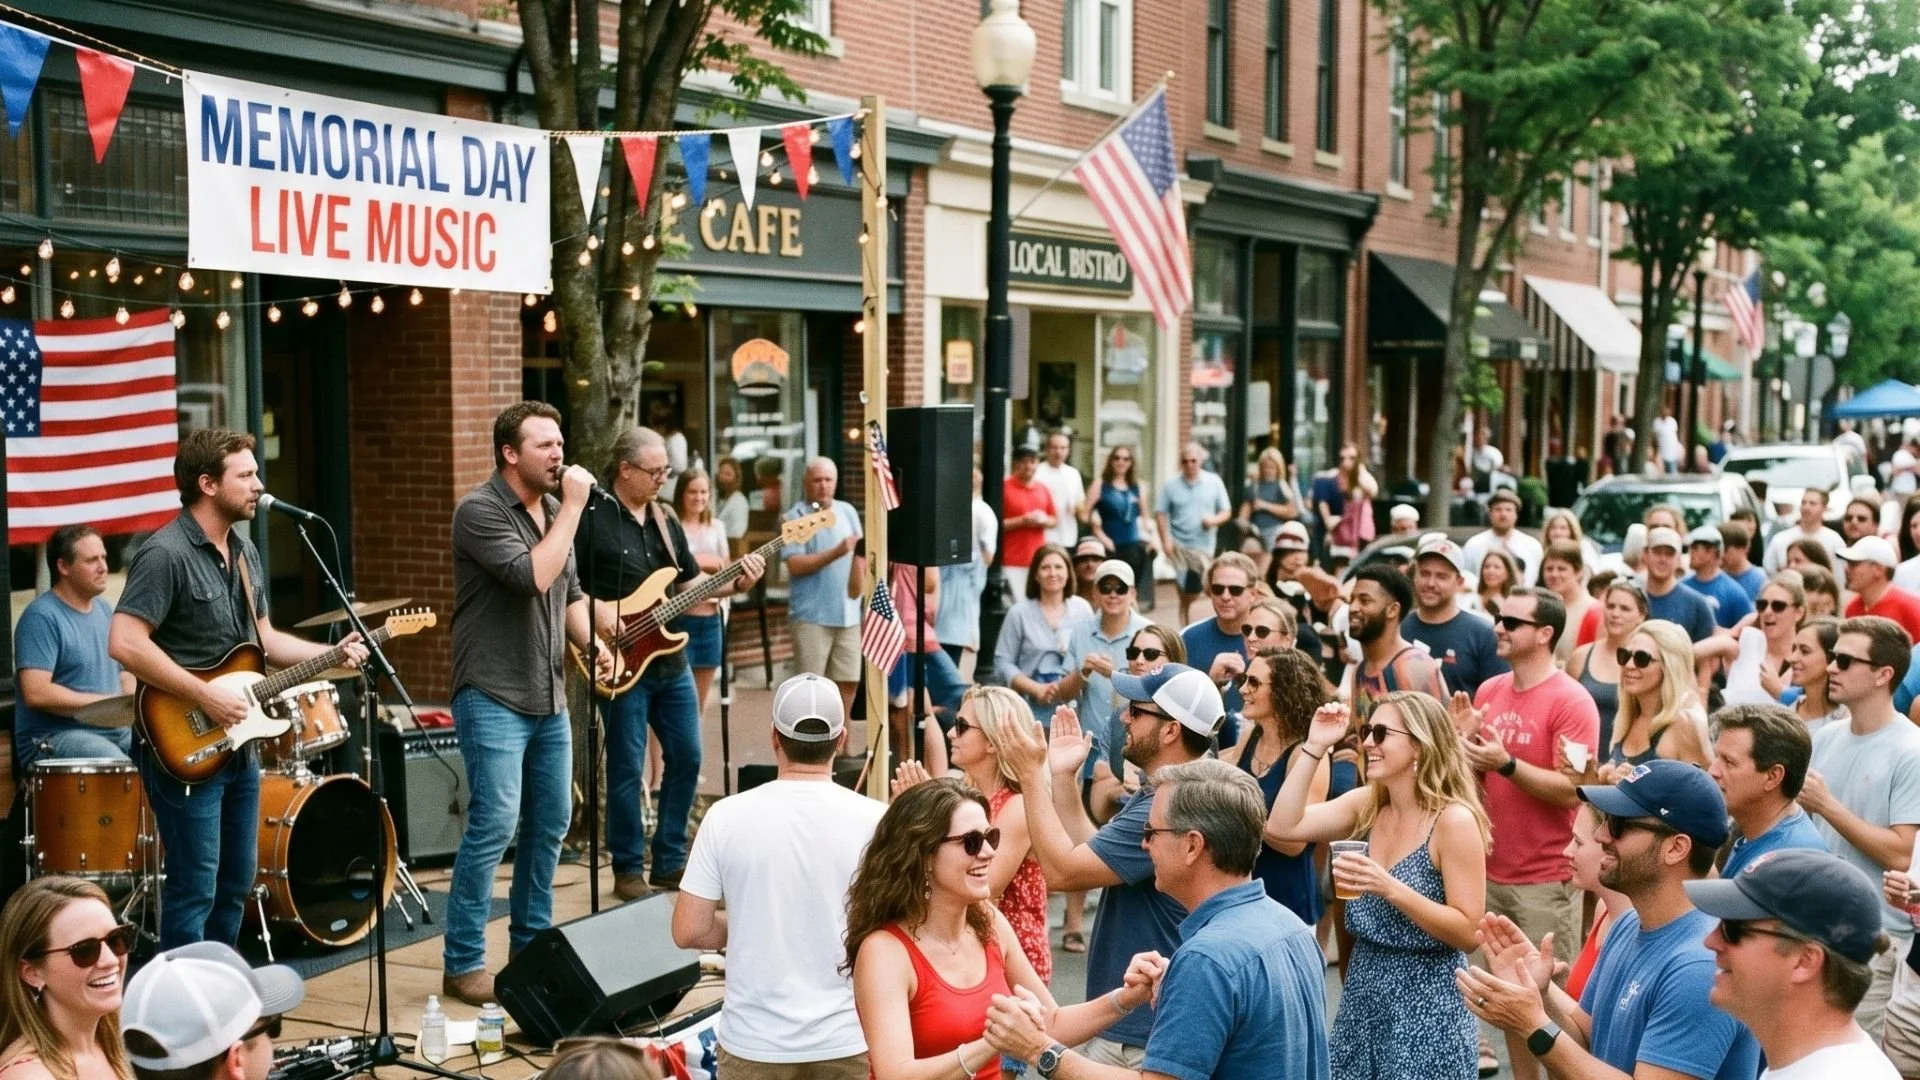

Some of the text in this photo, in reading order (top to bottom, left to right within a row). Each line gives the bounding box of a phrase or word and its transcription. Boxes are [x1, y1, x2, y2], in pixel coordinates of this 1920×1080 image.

[200, 94, 537, 204] MEMORIAL DAY
[250, 185, 497, 273] LIVE MUSIC
[700, 198, 804, 257] CAFE
[1008, 240, 1127, 284] LOCAL BISTRO
